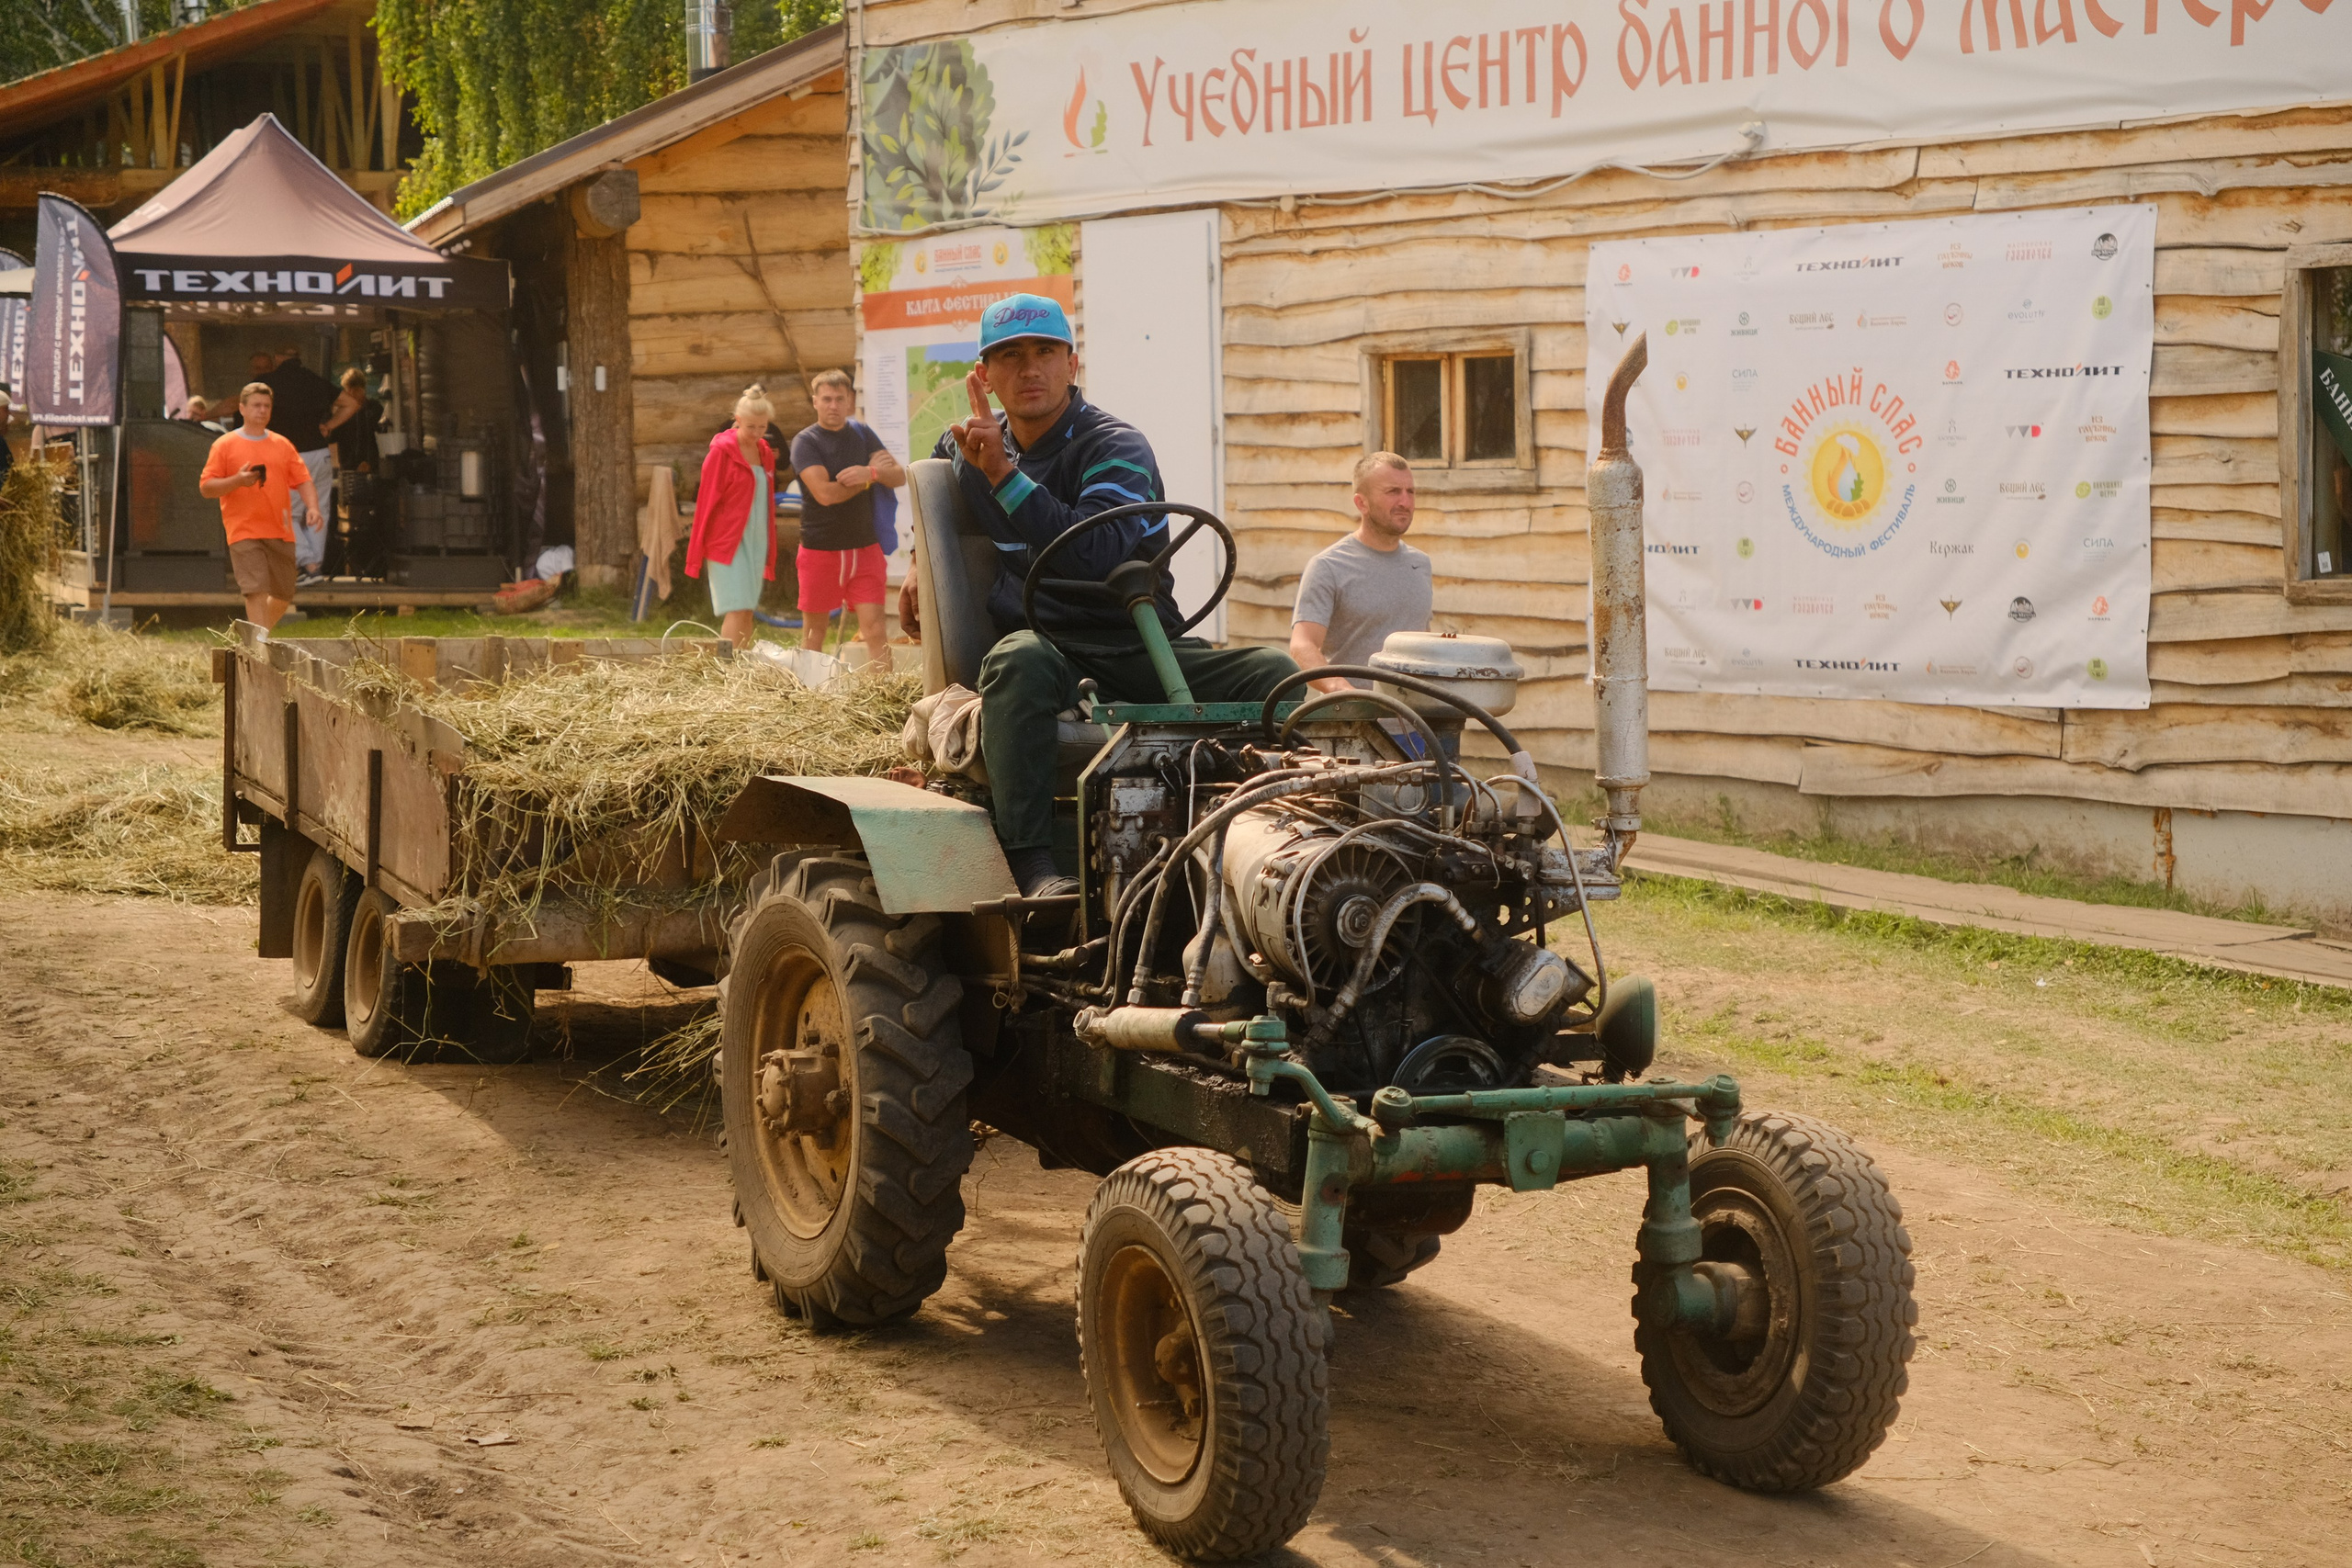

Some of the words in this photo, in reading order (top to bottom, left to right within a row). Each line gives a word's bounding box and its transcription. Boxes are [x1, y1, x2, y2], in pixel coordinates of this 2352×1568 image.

[1129, 26, 1373, 147] Учебный
[1403, 20, 1588, 129] центр
[1795, 255, 1905, 272] ТЕХНОЛИТ
[133, 263, 454, 299] ТЕХНОЛИТ
[906, 298, 942, 316] КАРТА
[1732, 369, 1758, 378] СИЛА
[2004, 362, 2124, 378] ТЕХНОЛИТ
[1774, 367, 1863, 457] БАННЫЙ
[1870, 382, 1923, 455] СПАС
[1782, 483, 1866, 558] МЕЖДУНАРОДНЫЙ
[1870, 483, 1916, 551] ФЕСТИВАЛЬ
[1929, 541, 1974, 558] Кержак
[2083, 537, 2114, 548] СИЛА
[1792, 658, 1902, 672] ТЕХНОЛИТ
